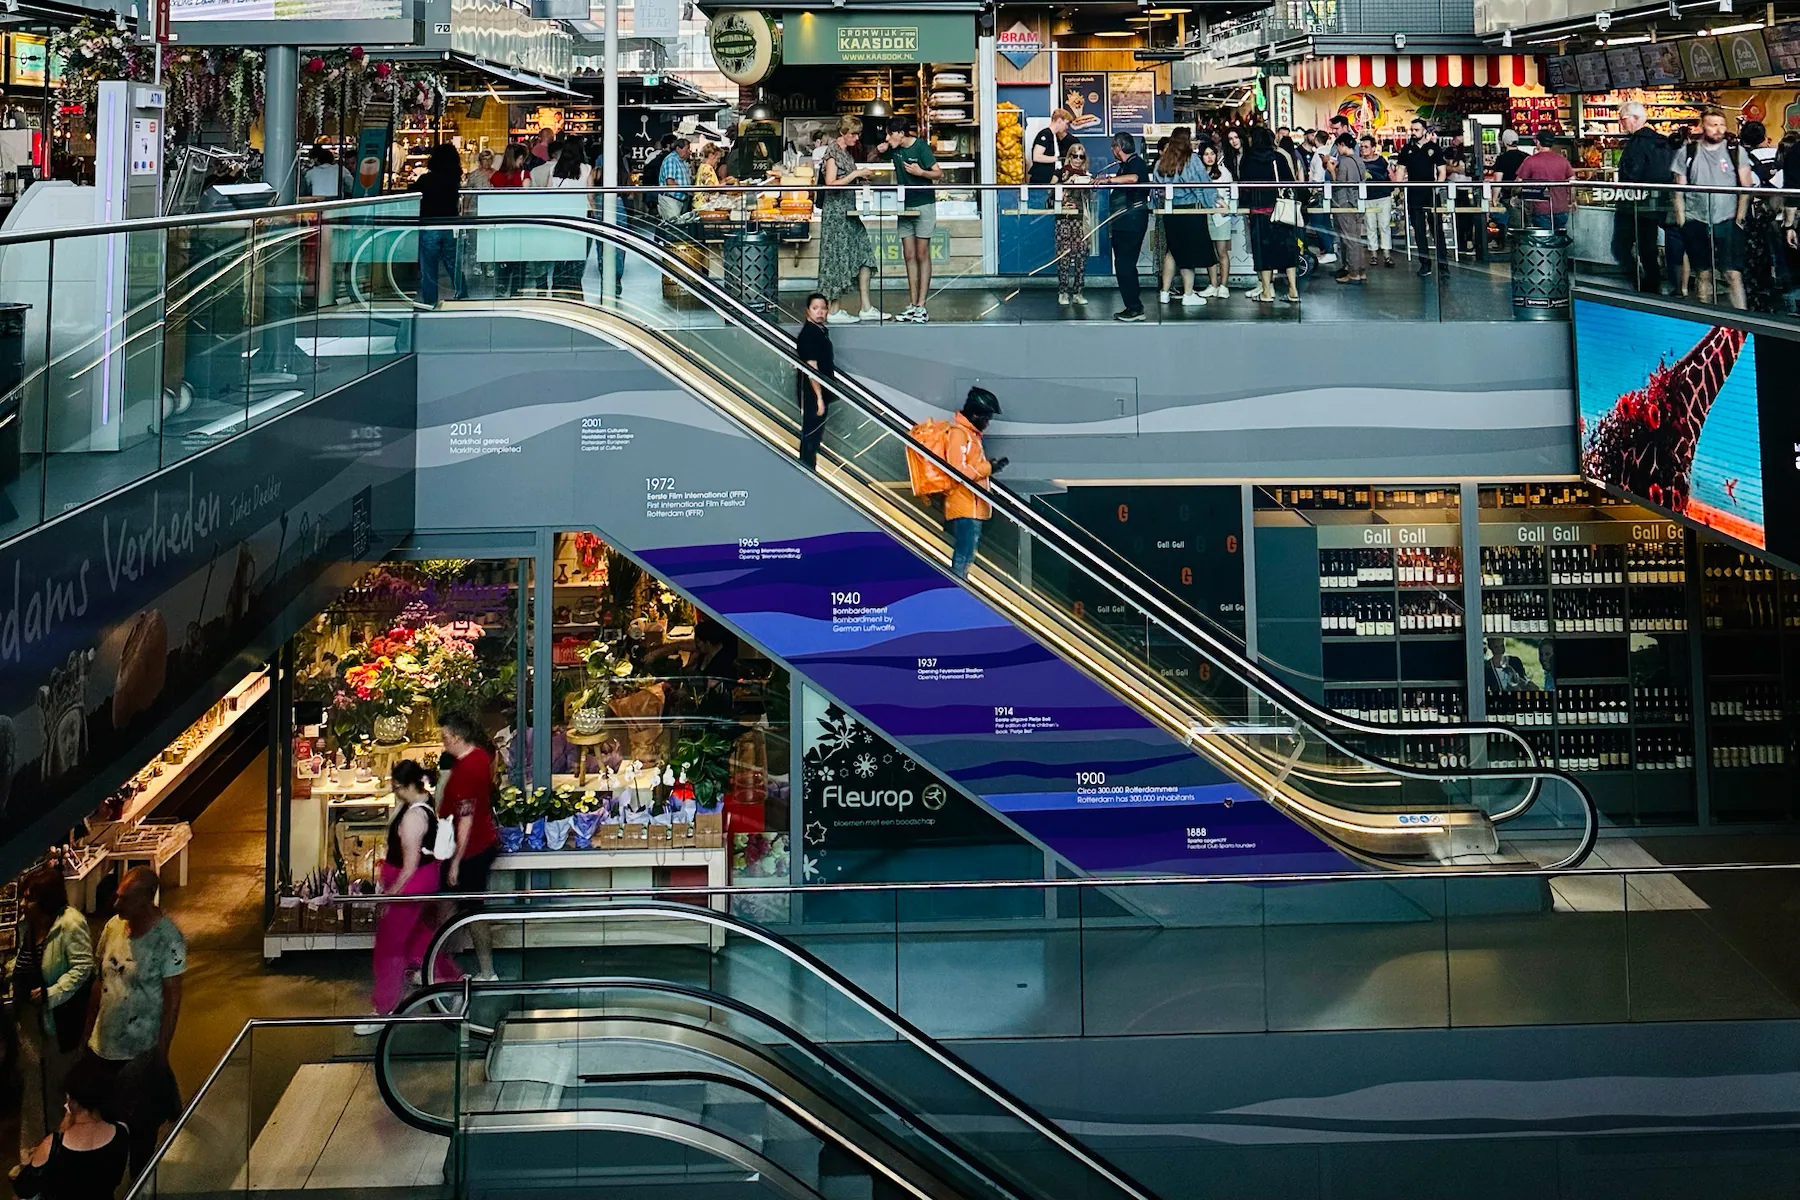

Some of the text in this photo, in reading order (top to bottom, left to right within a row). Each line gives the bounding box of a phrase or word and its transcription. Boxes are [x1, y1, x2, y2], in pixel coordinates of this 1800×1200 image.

[640, 8, 666, 18] TIJD
[640, 18, 671, 28] TRAP
[435, 24, 451, 33] 70
[840, 29, 897, 37] CROMWIJK
[1001, 32, 1038, 43] BRAM
[840, 38, 916, 49] KAASDOK
[1694, 53, 1708, 65] Bab
[1736, 48, 1751, 60] Bab
[1736, 59, 1757, 71] Tuma
[150, 93, 162, 105] ATM
[581, 419, 602, 428] 2001
[450, 423, 482, 436] 2014
[450, 437, 510, 446] Markthal gereed
[450, 445, 522, 455] Markthal completed
[646, 478, 675, 491] 1972
[647, 492, 667, 500] Eerste
[669, 492, 683, 500] Film
[684, 491, 728, 499] International
[647, 499, 745, 509] First International Film Festival
[647, 510, 684, 518] Rotterdam
[1117, 504, 1128, 522] G
[1364, 527, 1426, 544] Gall Gall
[1518, 525, 1579, 542] Gall Gall
[1632, 524, 1683, 540] Gall Ga
[738, 538, 759, 547] 1965
[1157, 540, 1184, 549] Gall Gall
[1226, 535, 1237, 553] G
[0, 558, 90, 663] dams
[103, 471, 220, 593] Verheden
[1181, 567, 1192, 585] G
[831, 591, 860, 604] 1940
[832, 606, 888, 615] Bombardement
[1220, 604, 1233, 612] Gall
[832, 615, 893, 624] Bombardment by
[832, 624, 895, 632] German Luftwaffe
[917, 658, 937, 667] 1937
[1161, 669, 1188, 677] Gall Gall
[994, 707, 1014, 716] 1914
[1075, 772, 1105, 785] 1900
[1077, 786, 1097, 794] Circa
[1097, 786, 1124, 794] 300.000
[822, 785, 914, 812] Fleurop
[1077, 793, 1195, 804] Rotterdam has 300.000 inhabitants
[1186, 828, 1206, 837] 1888
